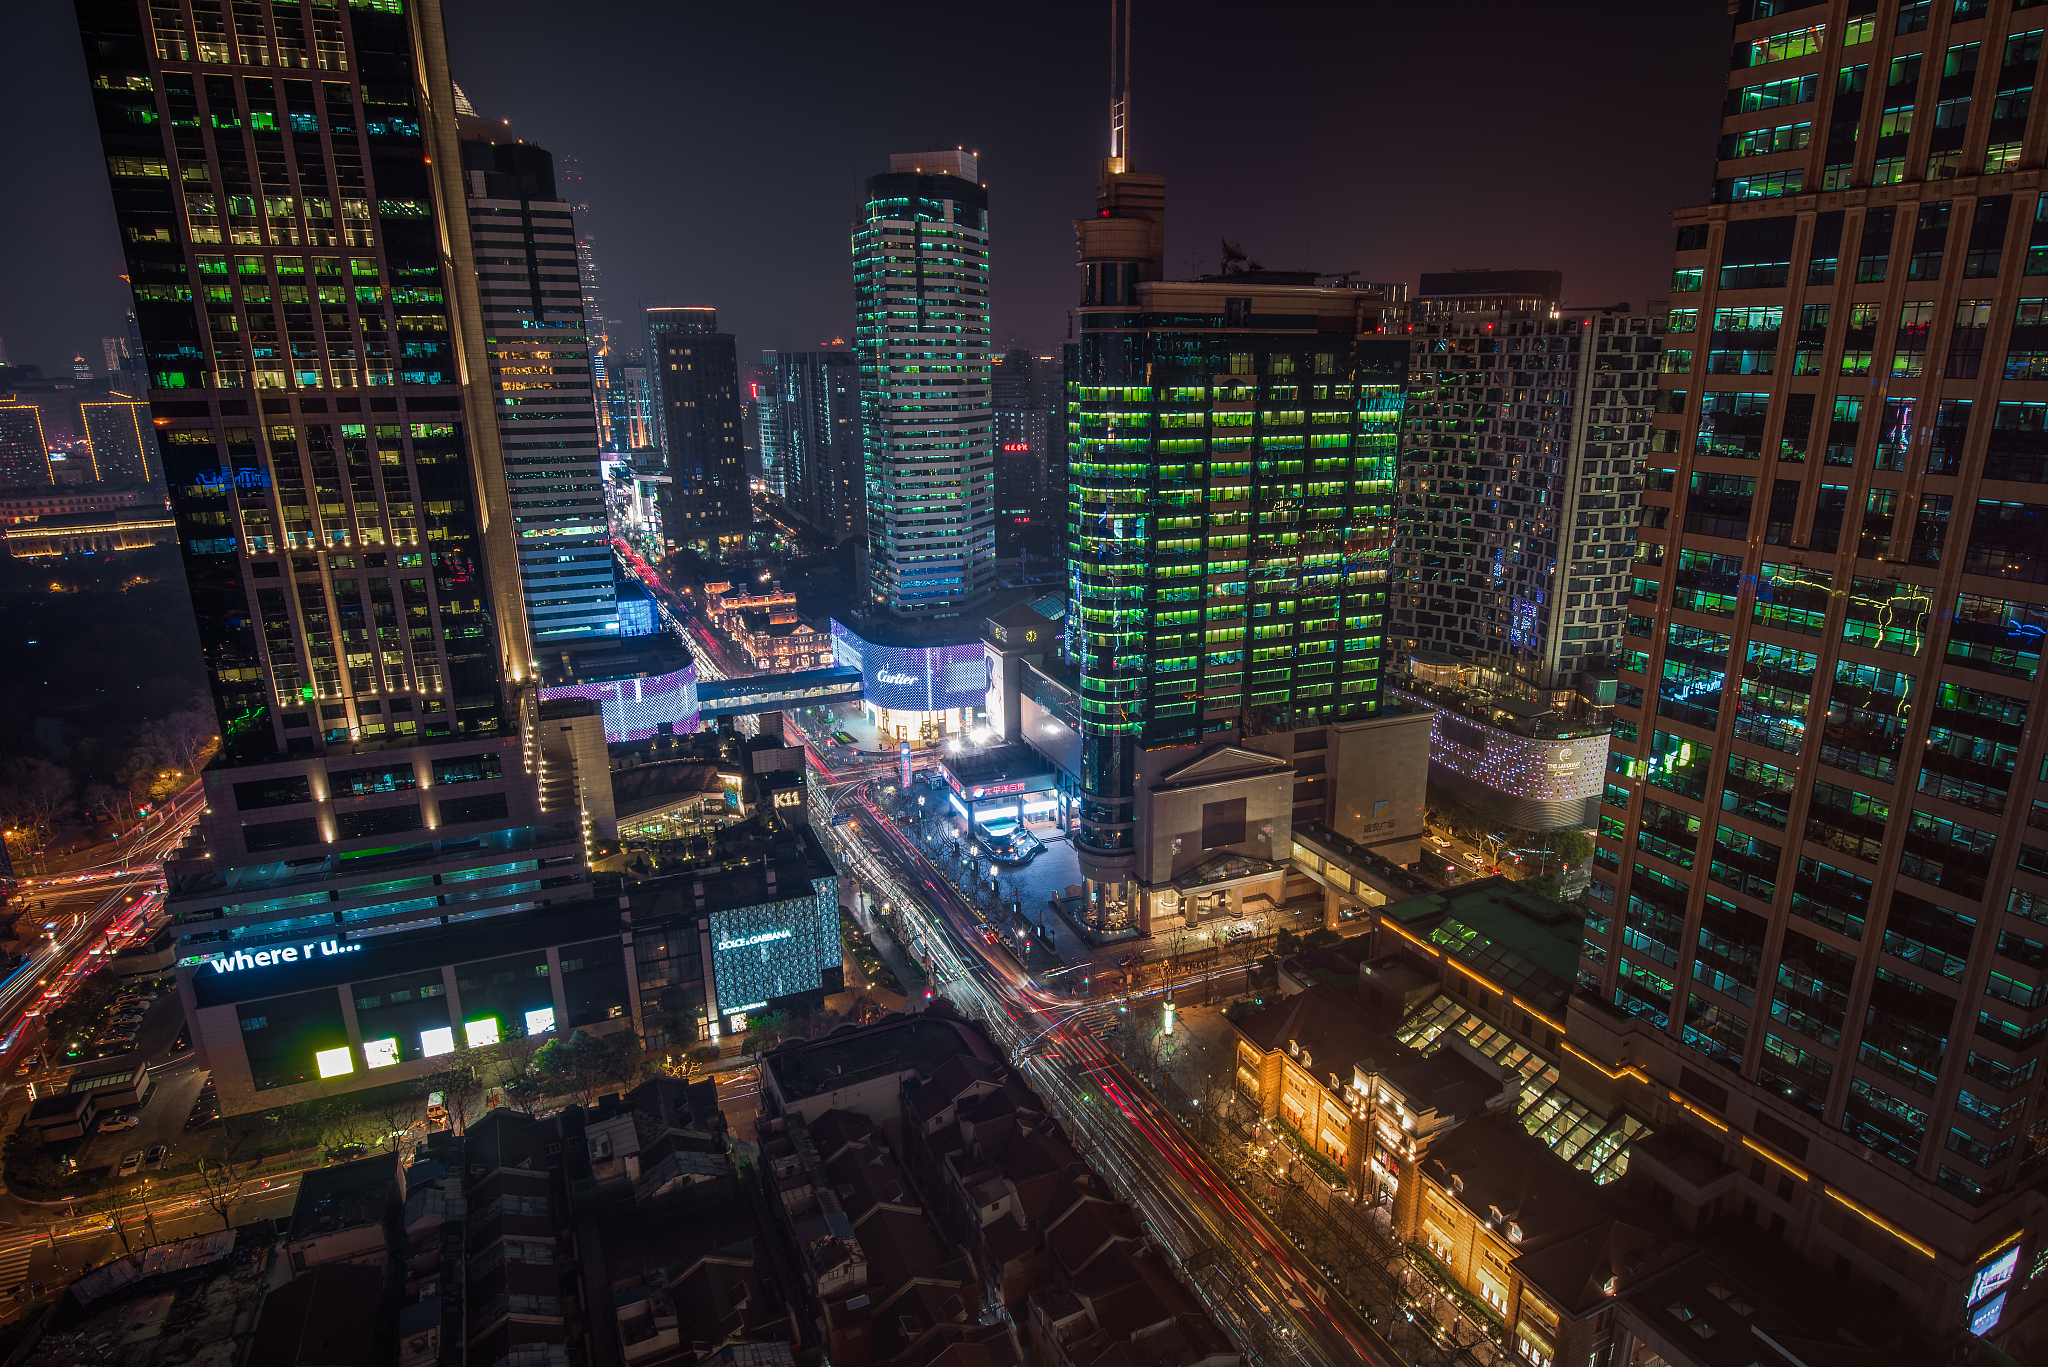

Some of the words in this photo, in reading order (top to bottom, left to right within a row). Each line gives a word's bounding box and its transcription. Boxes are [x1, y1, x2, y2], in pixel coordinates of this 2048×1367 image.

[877, 669, 919, 685] Cartier
[984, 782, 1025, 797] 太平洋百货
[774, 790, 801, 809] K11
[211, 949, 298, 974] where
[303, 943, 315, 959] r
